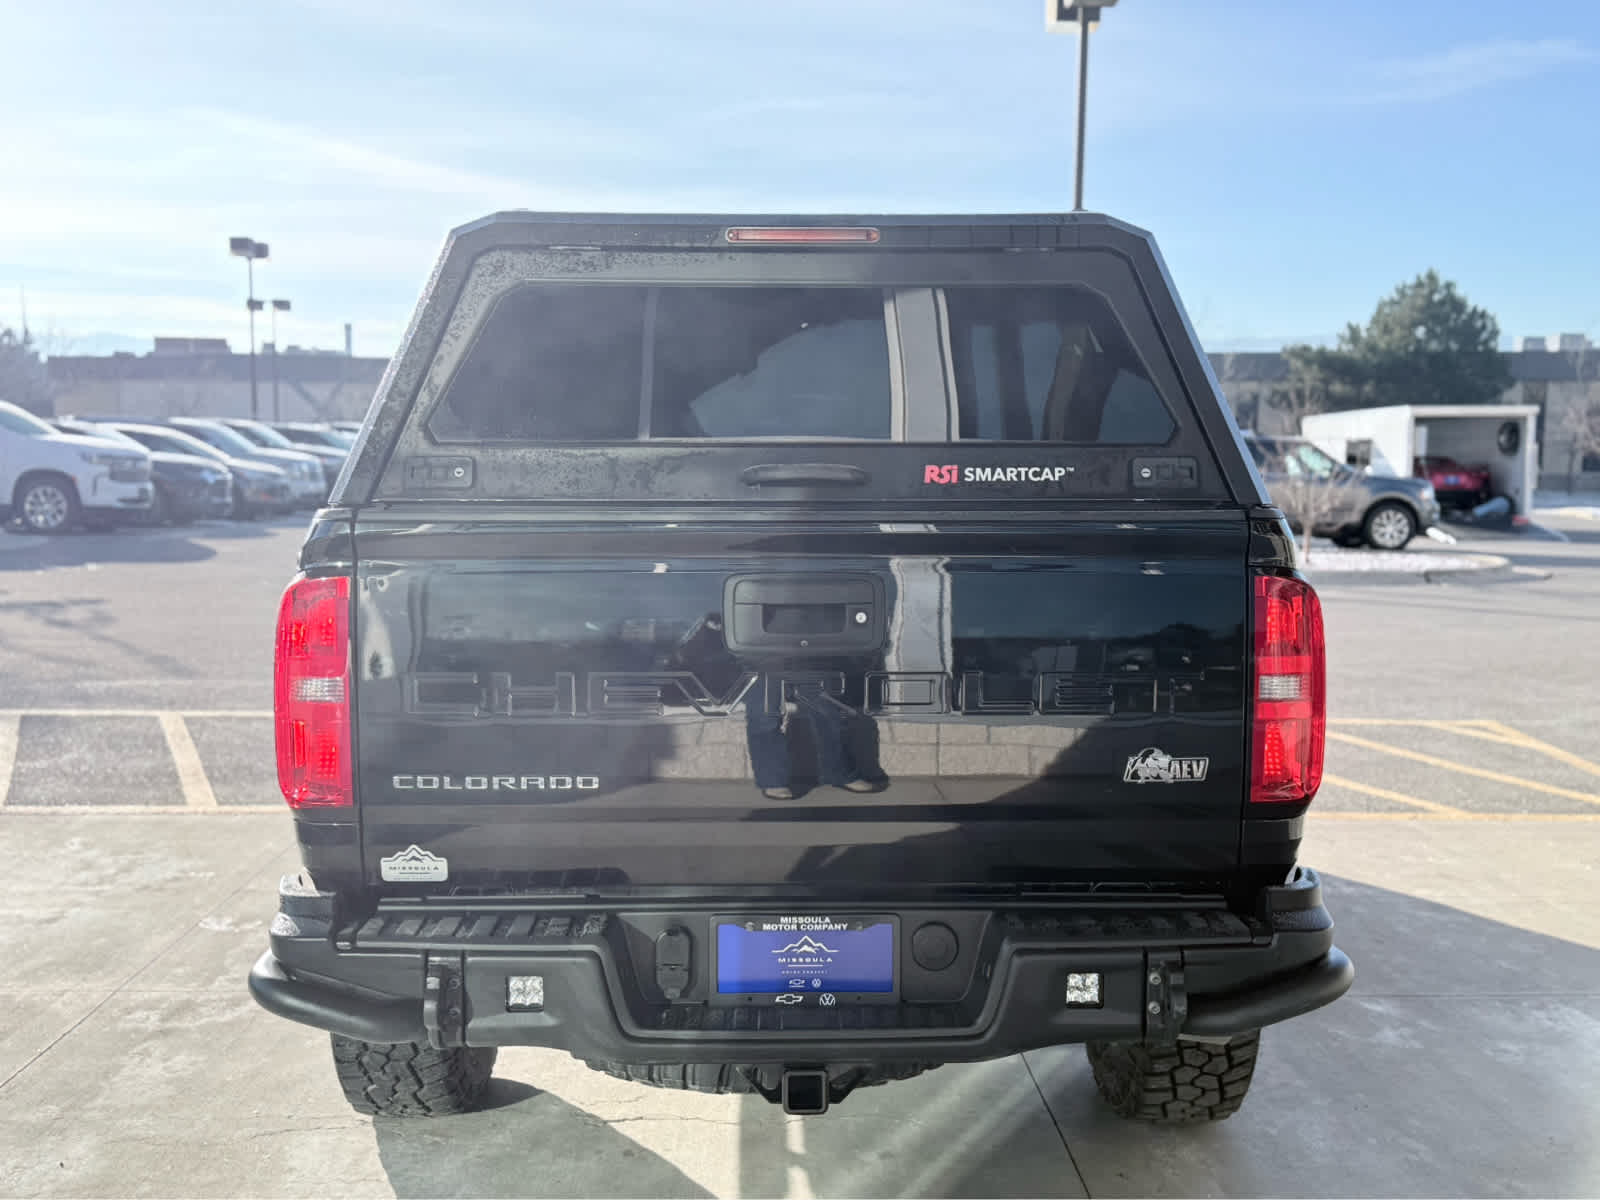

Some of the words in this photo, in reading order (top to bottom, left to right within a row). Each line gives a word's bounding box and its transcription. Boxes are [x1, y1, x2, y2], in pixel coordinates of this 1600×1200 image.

[1170, 760, 1205, 779] AEV
[392, 775, 600, 790] COLORADO
[780, 916, 831, 924] MISSOULA
[762, 923, 798, 931] MOTOR
[800, 923, 848, 931] COMPANY
